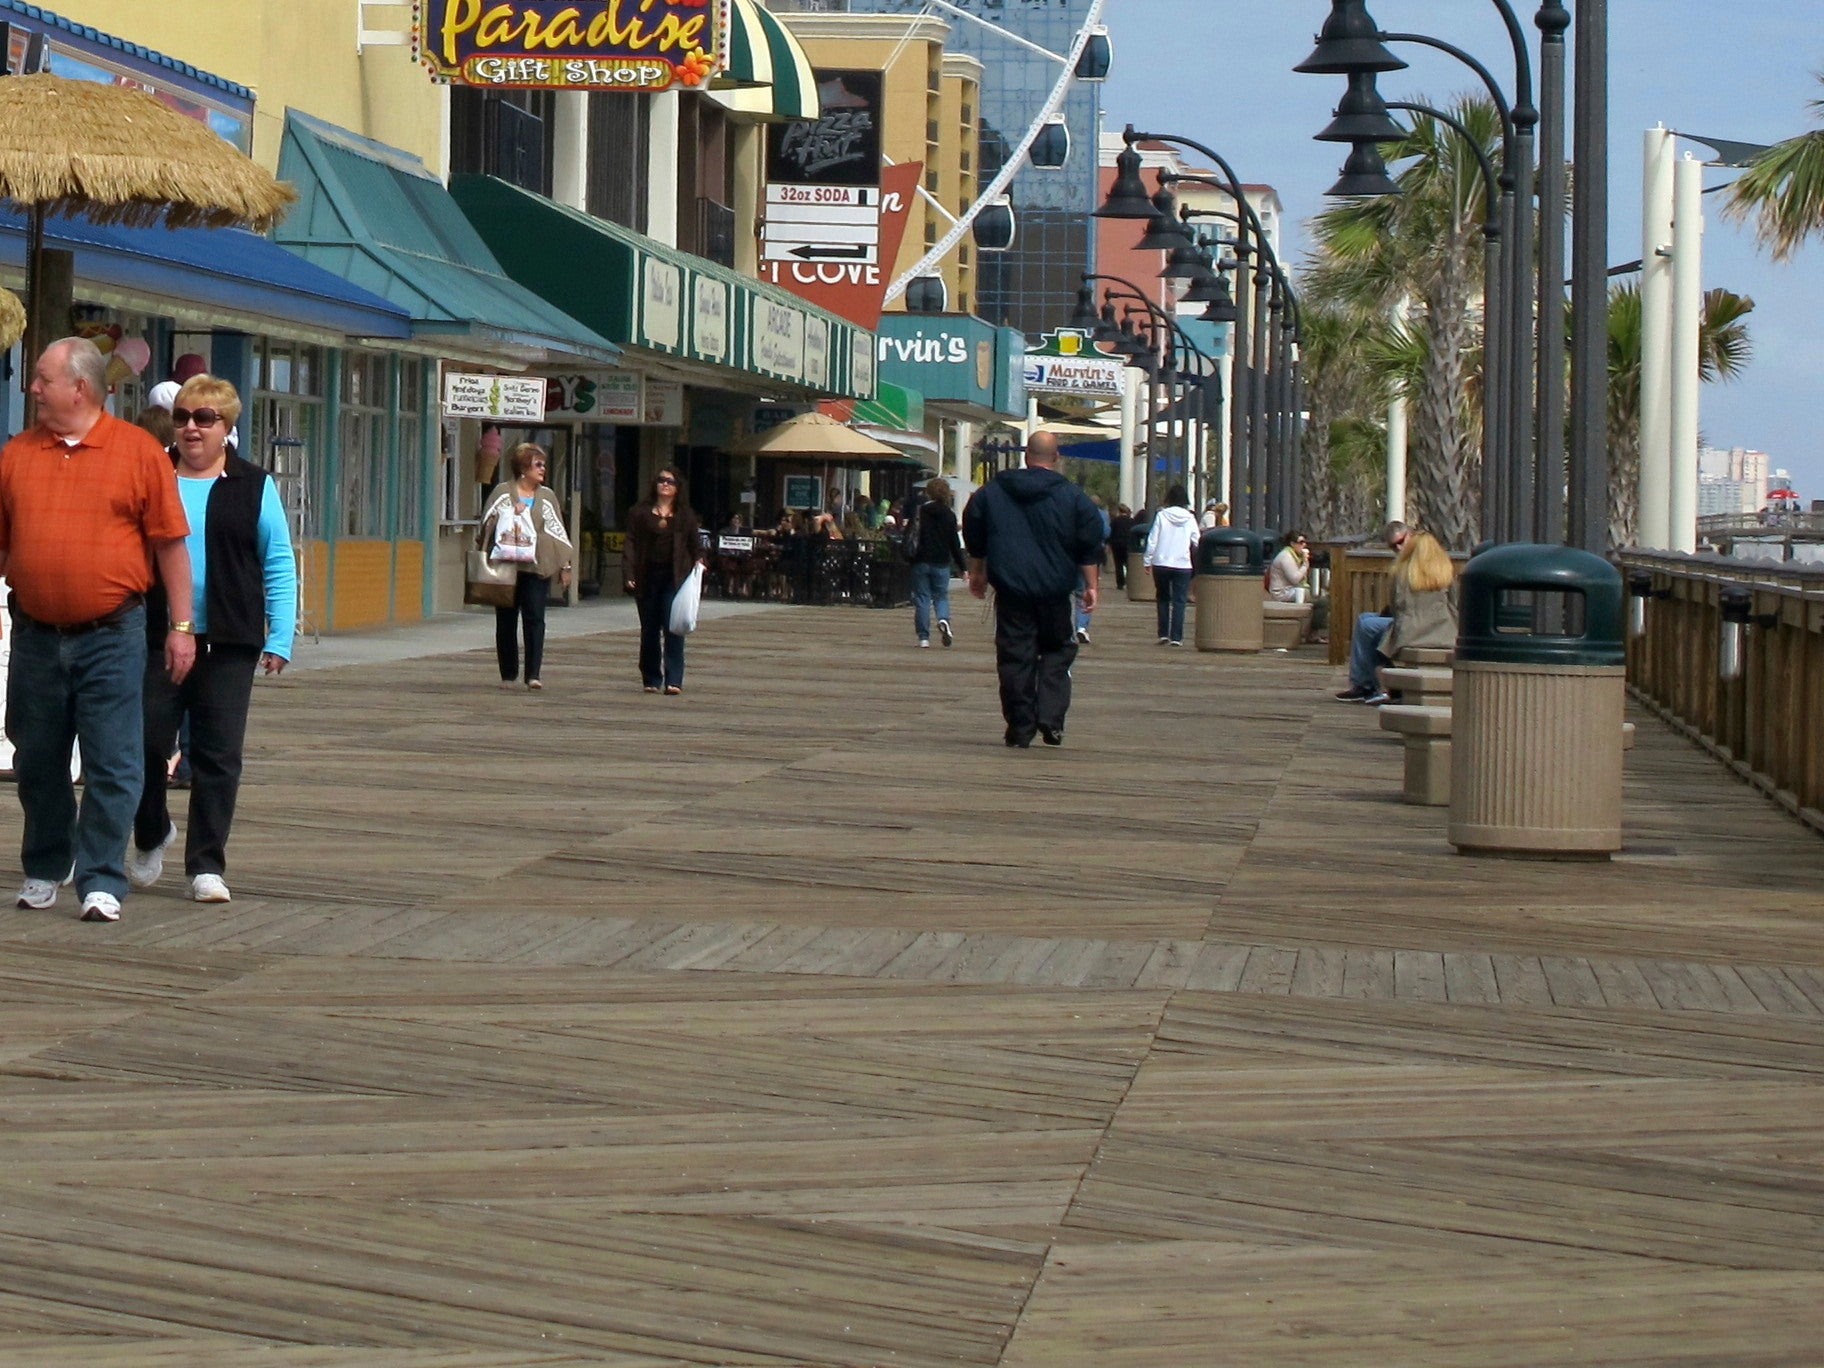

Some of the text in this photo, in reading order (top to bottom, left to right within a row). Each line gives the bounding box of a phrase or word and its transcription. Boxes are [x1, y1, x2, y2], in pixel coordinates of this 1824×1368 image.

[475, 57, 663, 85] Gift Shop
[780, 111, 873, 158] Pizza
[794, 131, 863, 169] Hut
[780, 187, 850, 203] 32oz SODA
[792, 263, 881, 285] COVE
[1048, 364, 1116, 381] Marvin's
